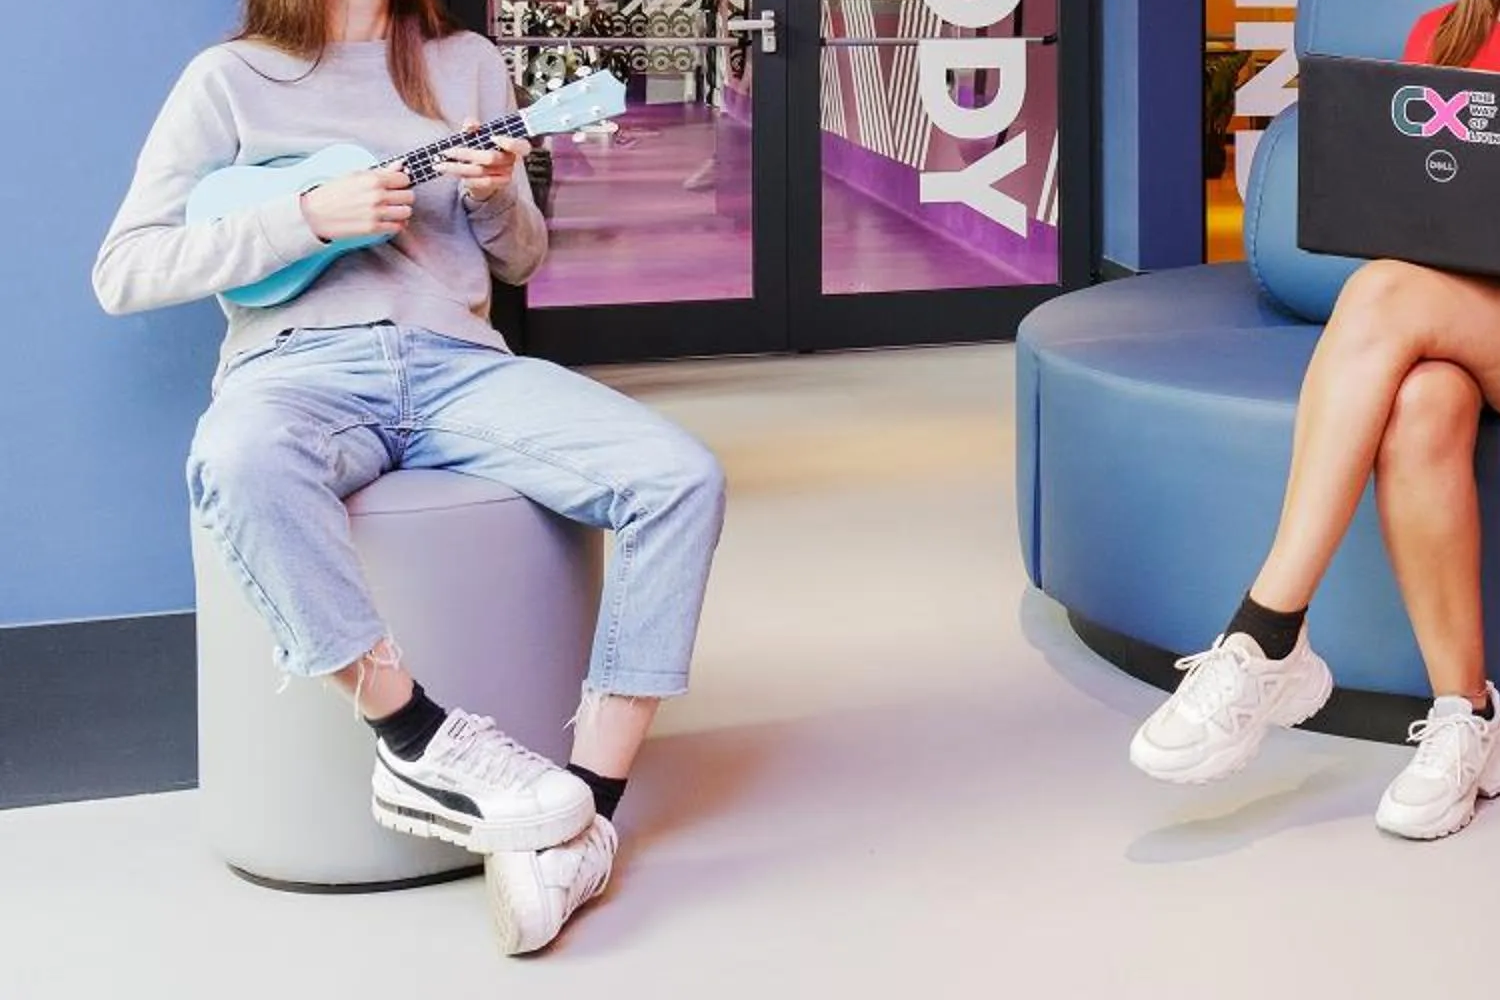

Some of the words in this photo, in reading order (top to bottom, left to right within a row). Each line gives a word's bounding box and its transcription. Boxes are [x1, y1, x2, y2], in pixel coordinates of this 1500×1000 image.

[1470, 91, 1495, 104] THE
[1391, 85, 1470, 141] CX
[1470, 104, 1498, 118] WAY
[1429, 160, 1456, 171] DELL
